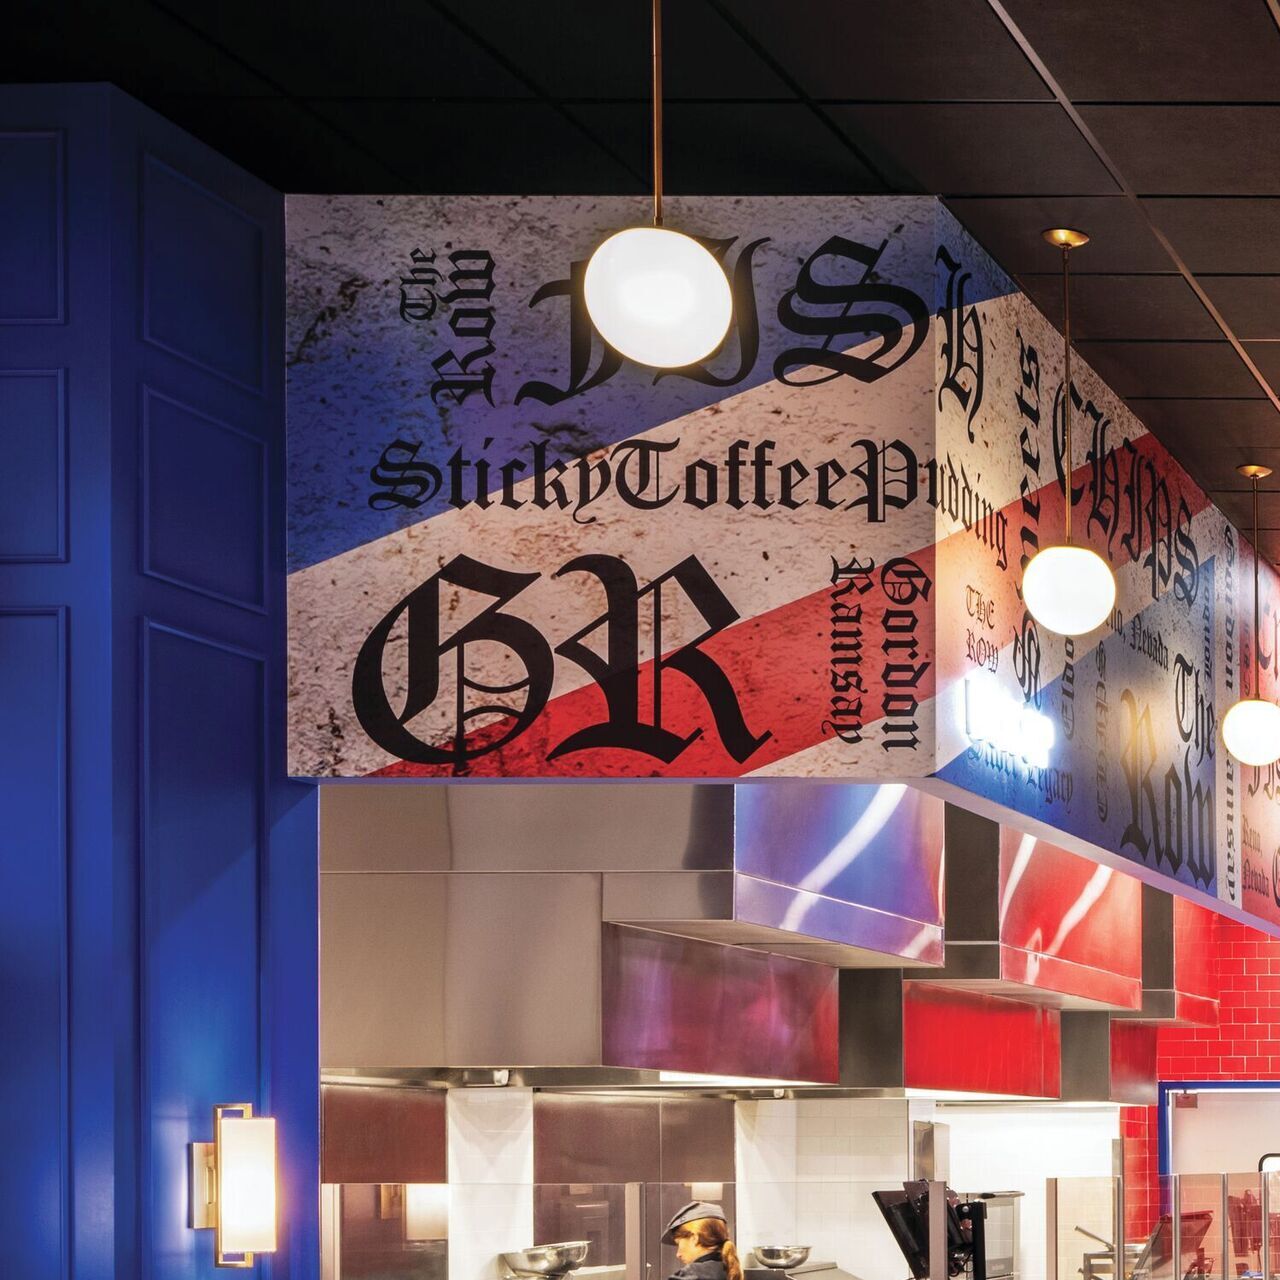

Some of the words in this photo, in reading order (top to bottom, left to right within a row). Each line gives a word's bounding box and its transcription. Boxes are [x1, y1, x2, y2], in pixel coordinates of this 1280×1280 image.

[401, 247, 446, 324] The
[430, 248, 497, 408] Row
[1052, 382, 1199, 607] CHIPS
[351, 553, 774, 765] GR
[821, 554, 875, 746] Ramsay
[878, 555, 933, 754] Gordon
[965, 584, 995, 630] THE
[965, 628, 998, 674] ROW
[1129, 612, 1170, 672] Nevada
[1174, 652, 1218, 768] The
[1120, 688, 1217, 890] Row
[1226, 749, 1237, 904] amsay
